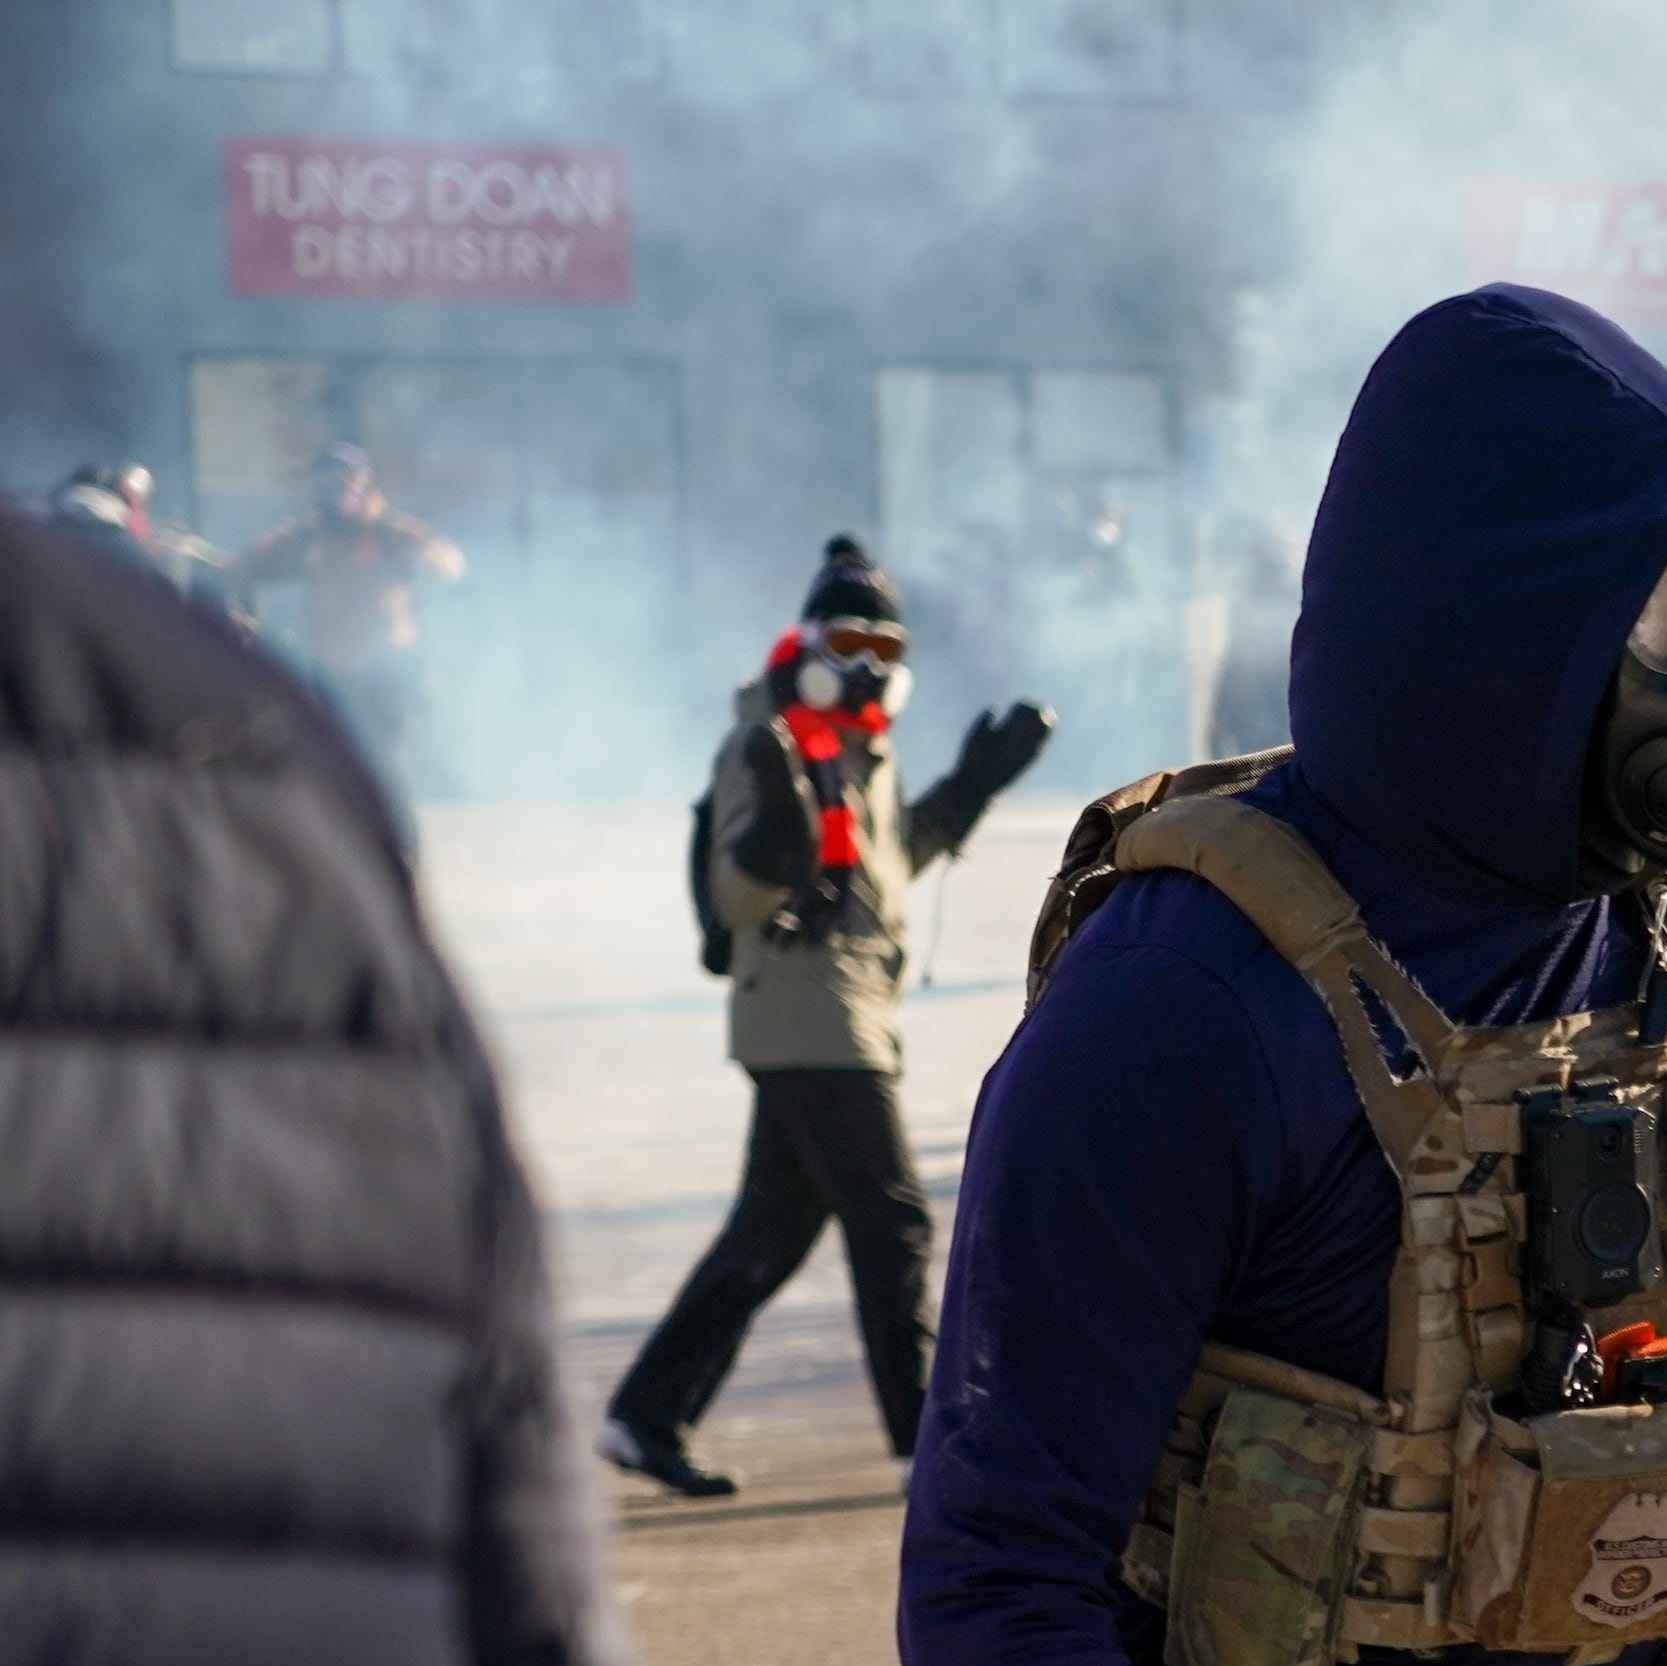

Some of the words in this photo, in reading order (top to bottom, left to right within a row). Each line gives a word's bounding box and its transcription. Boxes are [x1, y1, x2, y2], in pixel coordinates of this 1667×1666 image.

[243, 154, 410, 223] TUNG
[428, 159, 612, 228] DOAN
[293, 226, 574, 283] DENTISTRY
